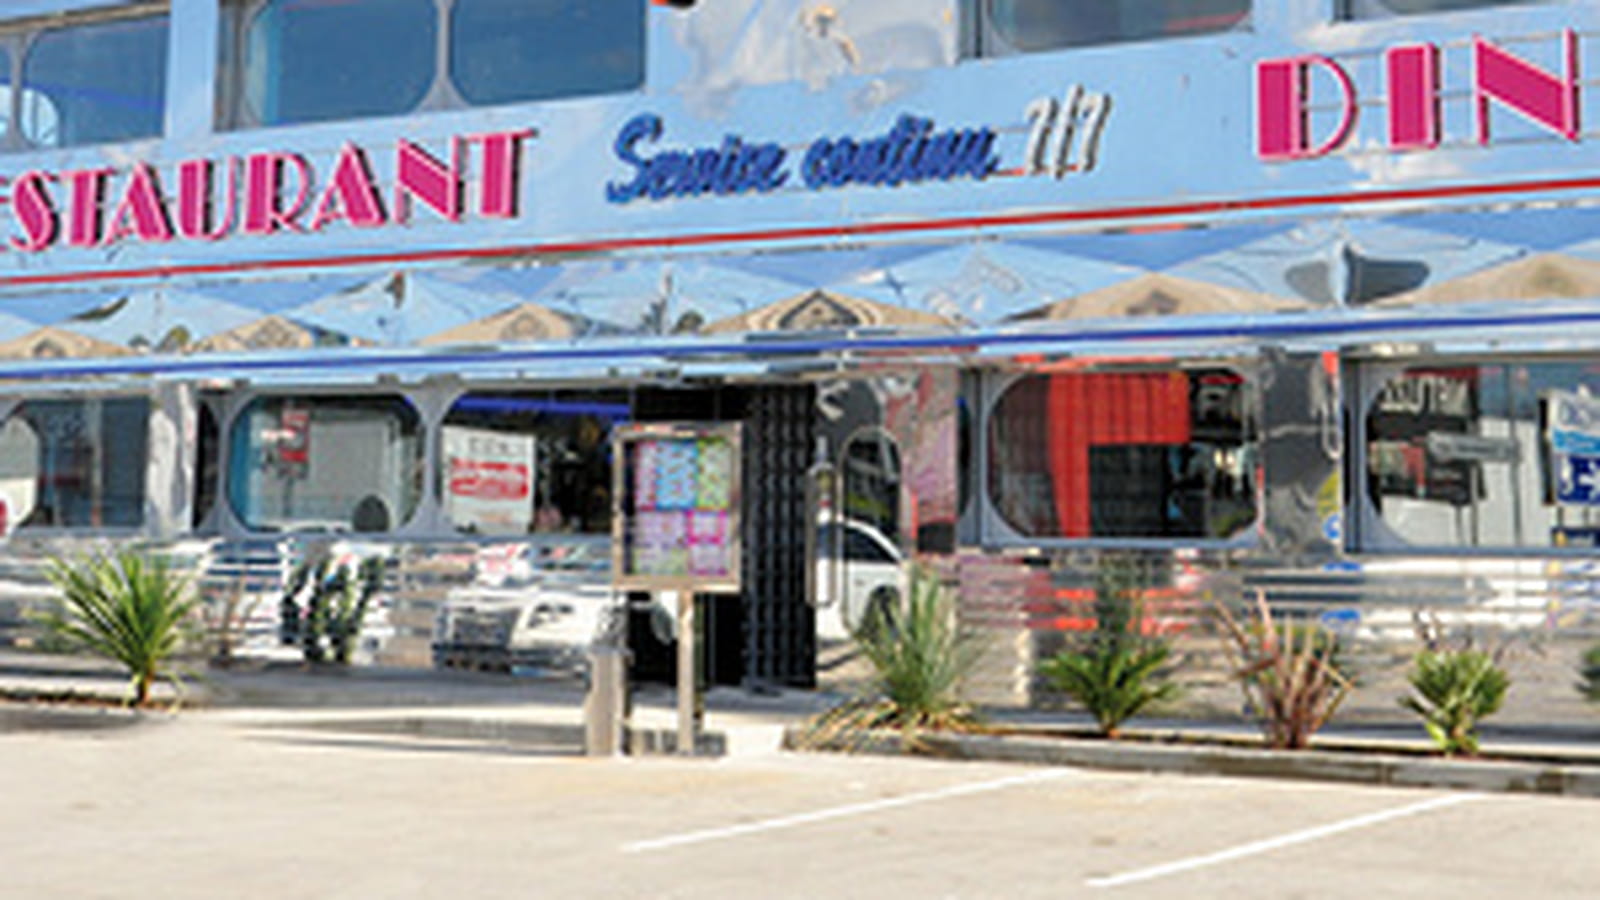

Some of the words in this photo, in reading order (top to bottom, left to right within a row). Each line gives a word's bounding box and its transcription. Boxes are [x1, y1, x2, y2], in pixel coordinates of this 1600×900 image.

[606, 113, 792, 203] Service
[802, 113, 998, 191] continu
[1026, 85, 1111, 179] 7/7
[1256, 28, 1580, 160] DIN
